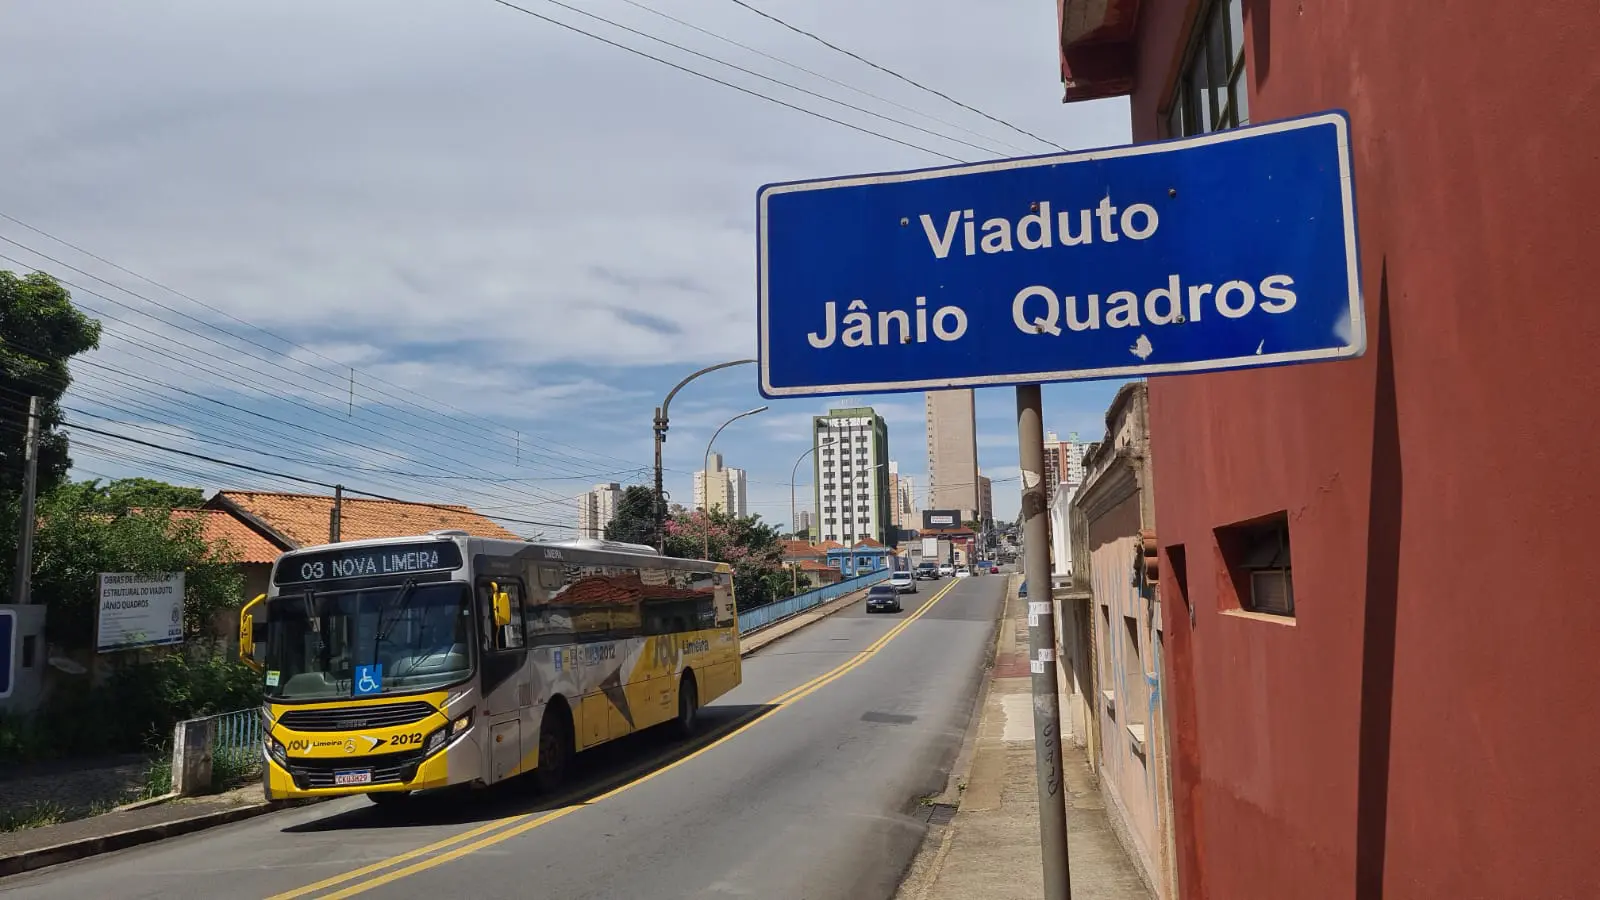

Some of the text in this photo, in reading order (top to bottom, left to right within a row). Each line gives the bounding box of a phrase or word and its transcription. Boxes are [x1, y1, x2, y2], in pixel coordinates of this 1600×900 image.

[919, 195, 1159, 259] Viaduto
[807, 274, 1297, 349] Jânio Quadros
[301, 551, 439, 580] 03 NOVA LIMEIRA
[103, 576, 125, 585] OBRAS
[125, 575, 133, 584] DE
[103, 586, 173, 598] ESTRUTURAL DO VIADUTO
[121, 600, 149, 610] QUADROS
[599, 644, 616, 660] 2012
[390, 733, 423, 746] 2012
